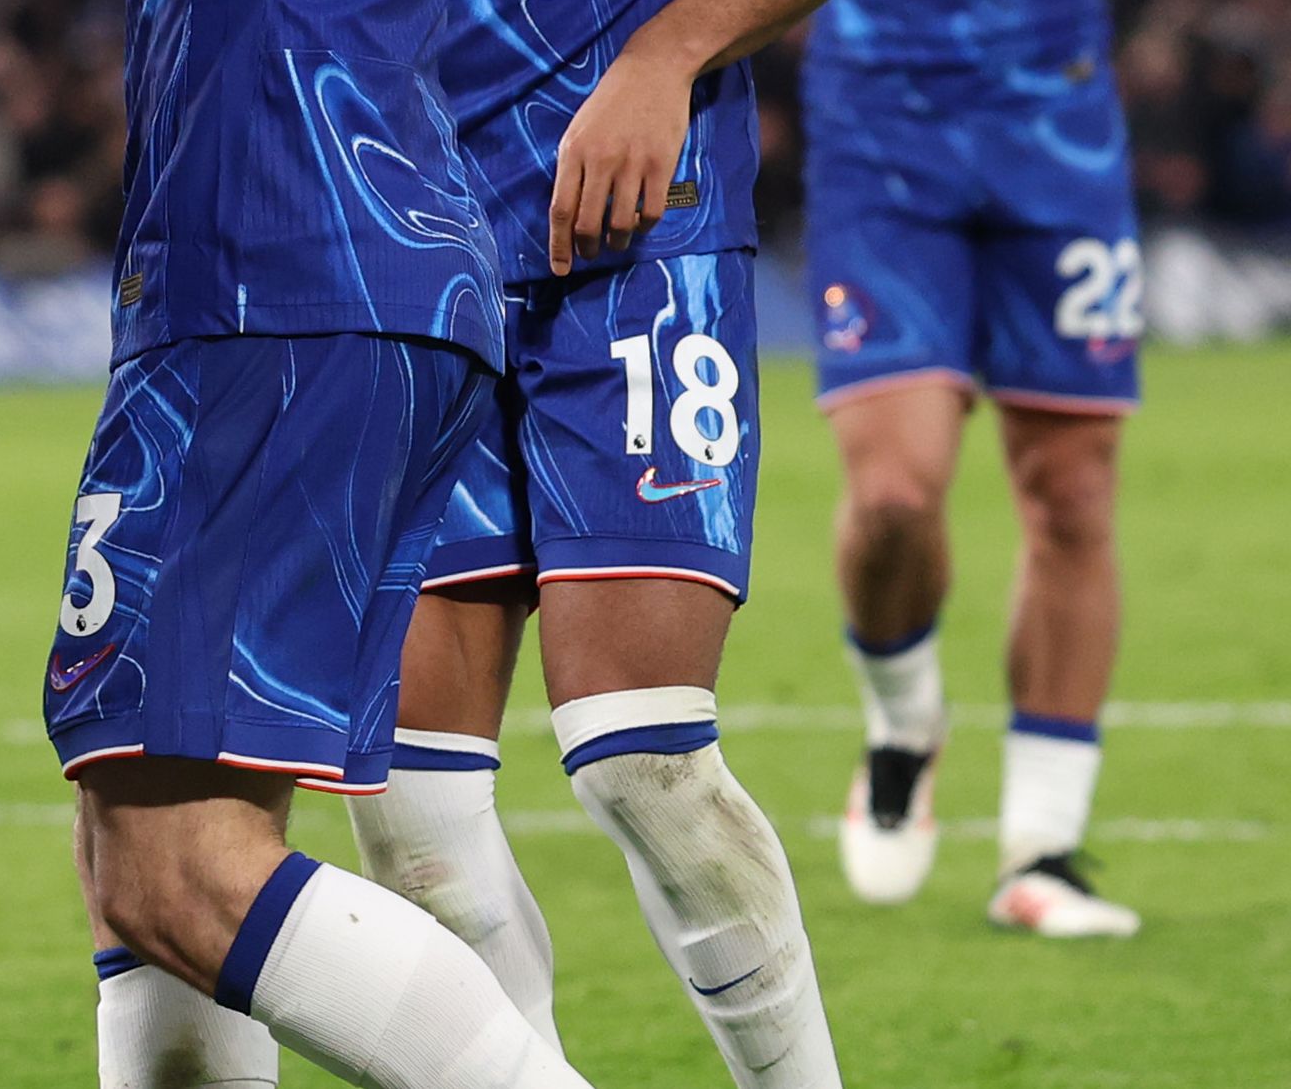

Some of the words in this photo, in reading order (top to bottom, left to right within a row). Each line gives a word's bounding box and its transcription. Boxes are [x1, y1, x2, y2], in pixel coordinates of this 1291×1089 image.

[1052, 236, 1143, 339] 22
[609, 333, 740, 468] 18
[59, 492, 123, 637] 3
